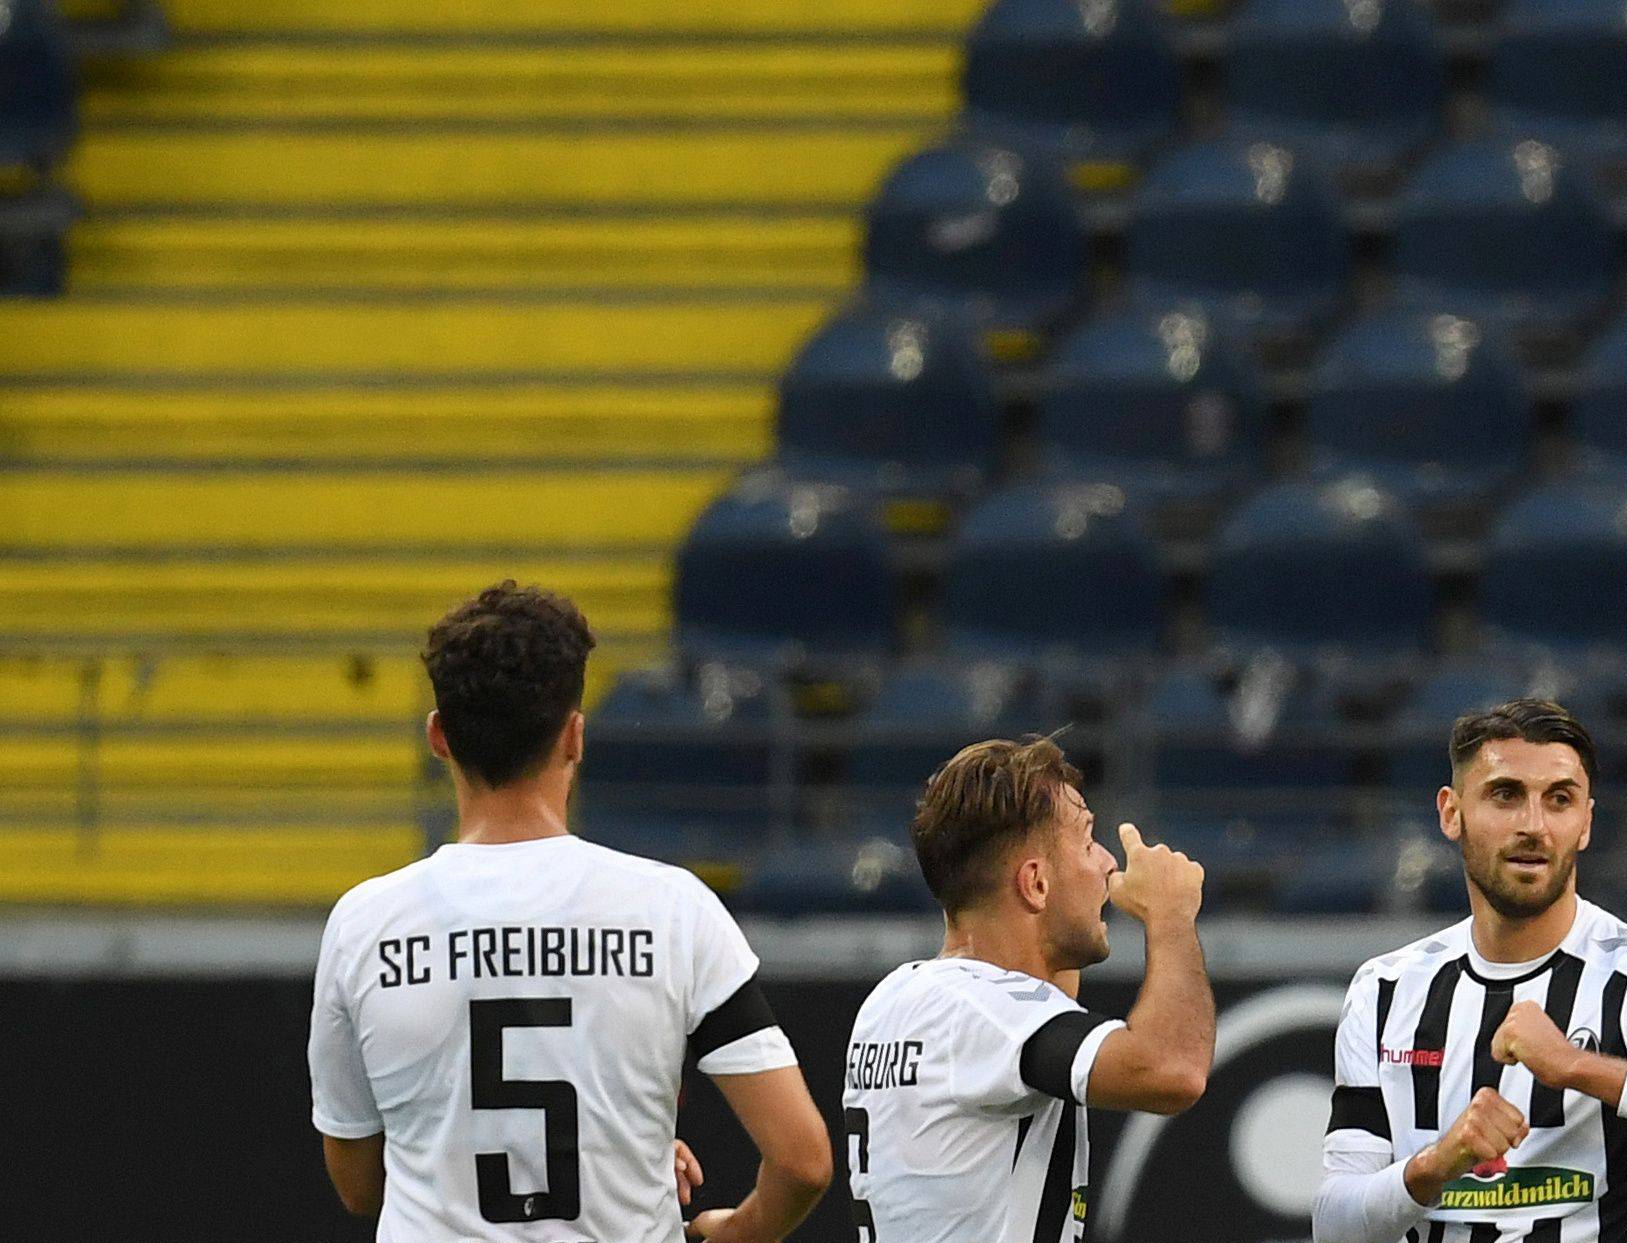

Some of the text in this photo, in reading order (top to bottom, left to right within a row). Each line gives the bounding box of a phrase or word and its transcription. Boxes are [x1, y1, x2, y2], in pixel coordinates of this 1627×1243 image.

[378, 927, 655, 988] SC FREIBURG
[469, 997, 581, 1223] 5
